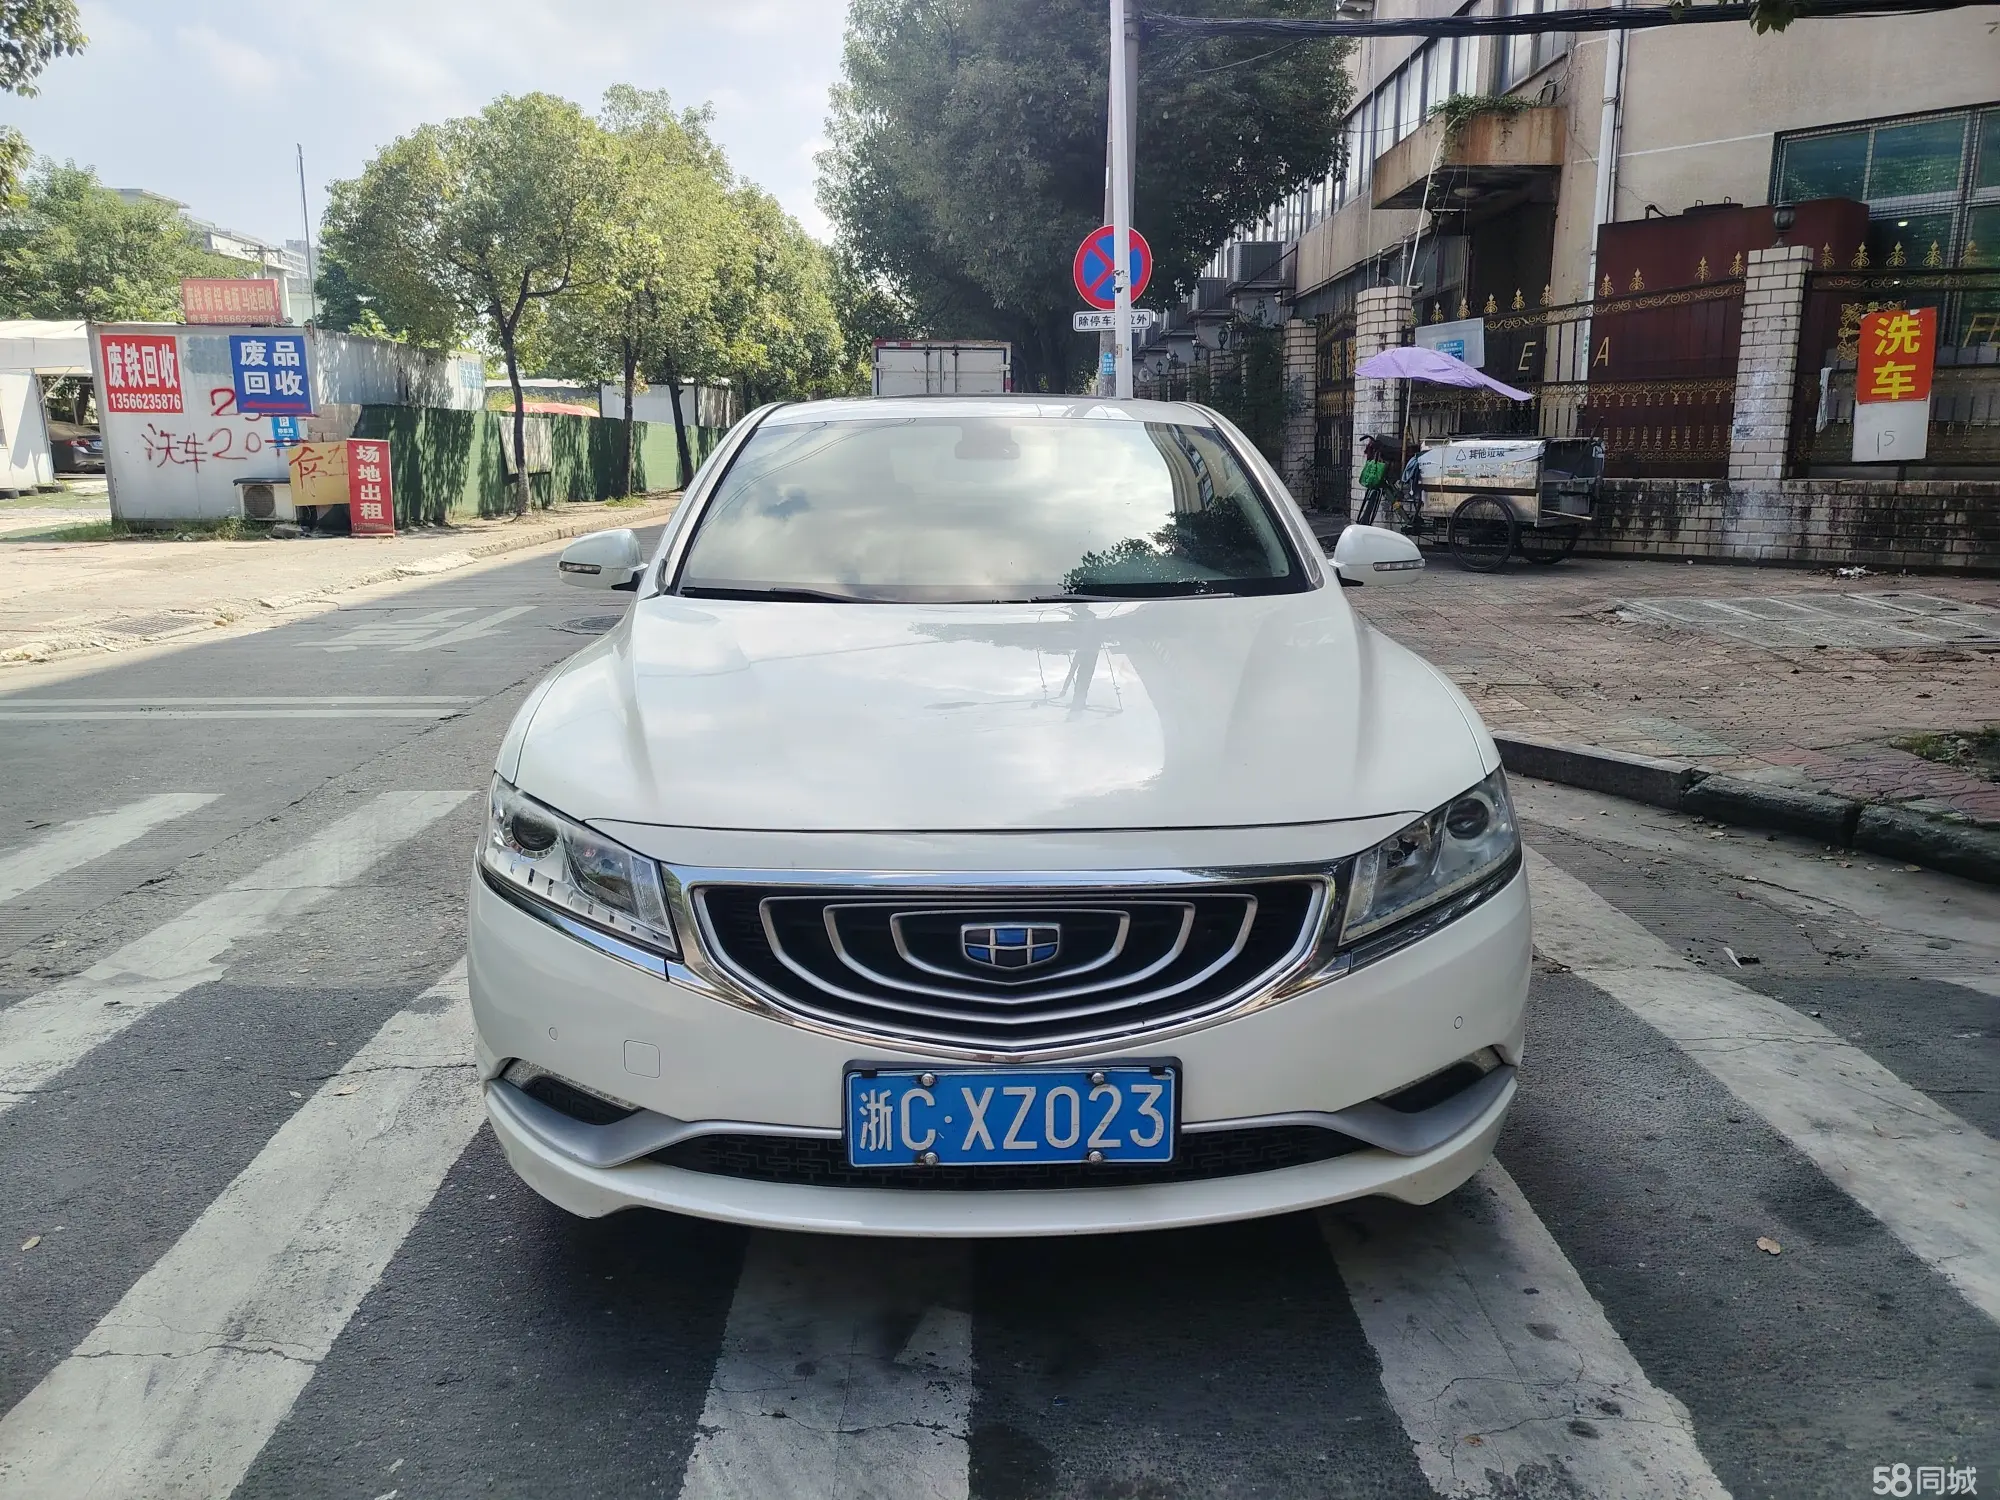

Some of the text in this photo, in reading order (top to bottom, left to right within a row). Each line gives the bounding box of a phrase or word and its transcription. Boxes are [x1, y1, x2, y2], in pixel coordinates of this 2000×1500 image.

[1078, 314, 1147, 327] 除停车外
[106, 342, 178, 389] 废铁回收
[240, 340, 300, 367] 废品
[1870, 314, 1921, 400] 洗车
[243, 370, 304, 396] 回收
[110, 393, 181, 410] 13566235876
[1876, 430, 1896, 455] 15
[356, 445, 384, 519] 场地出租
